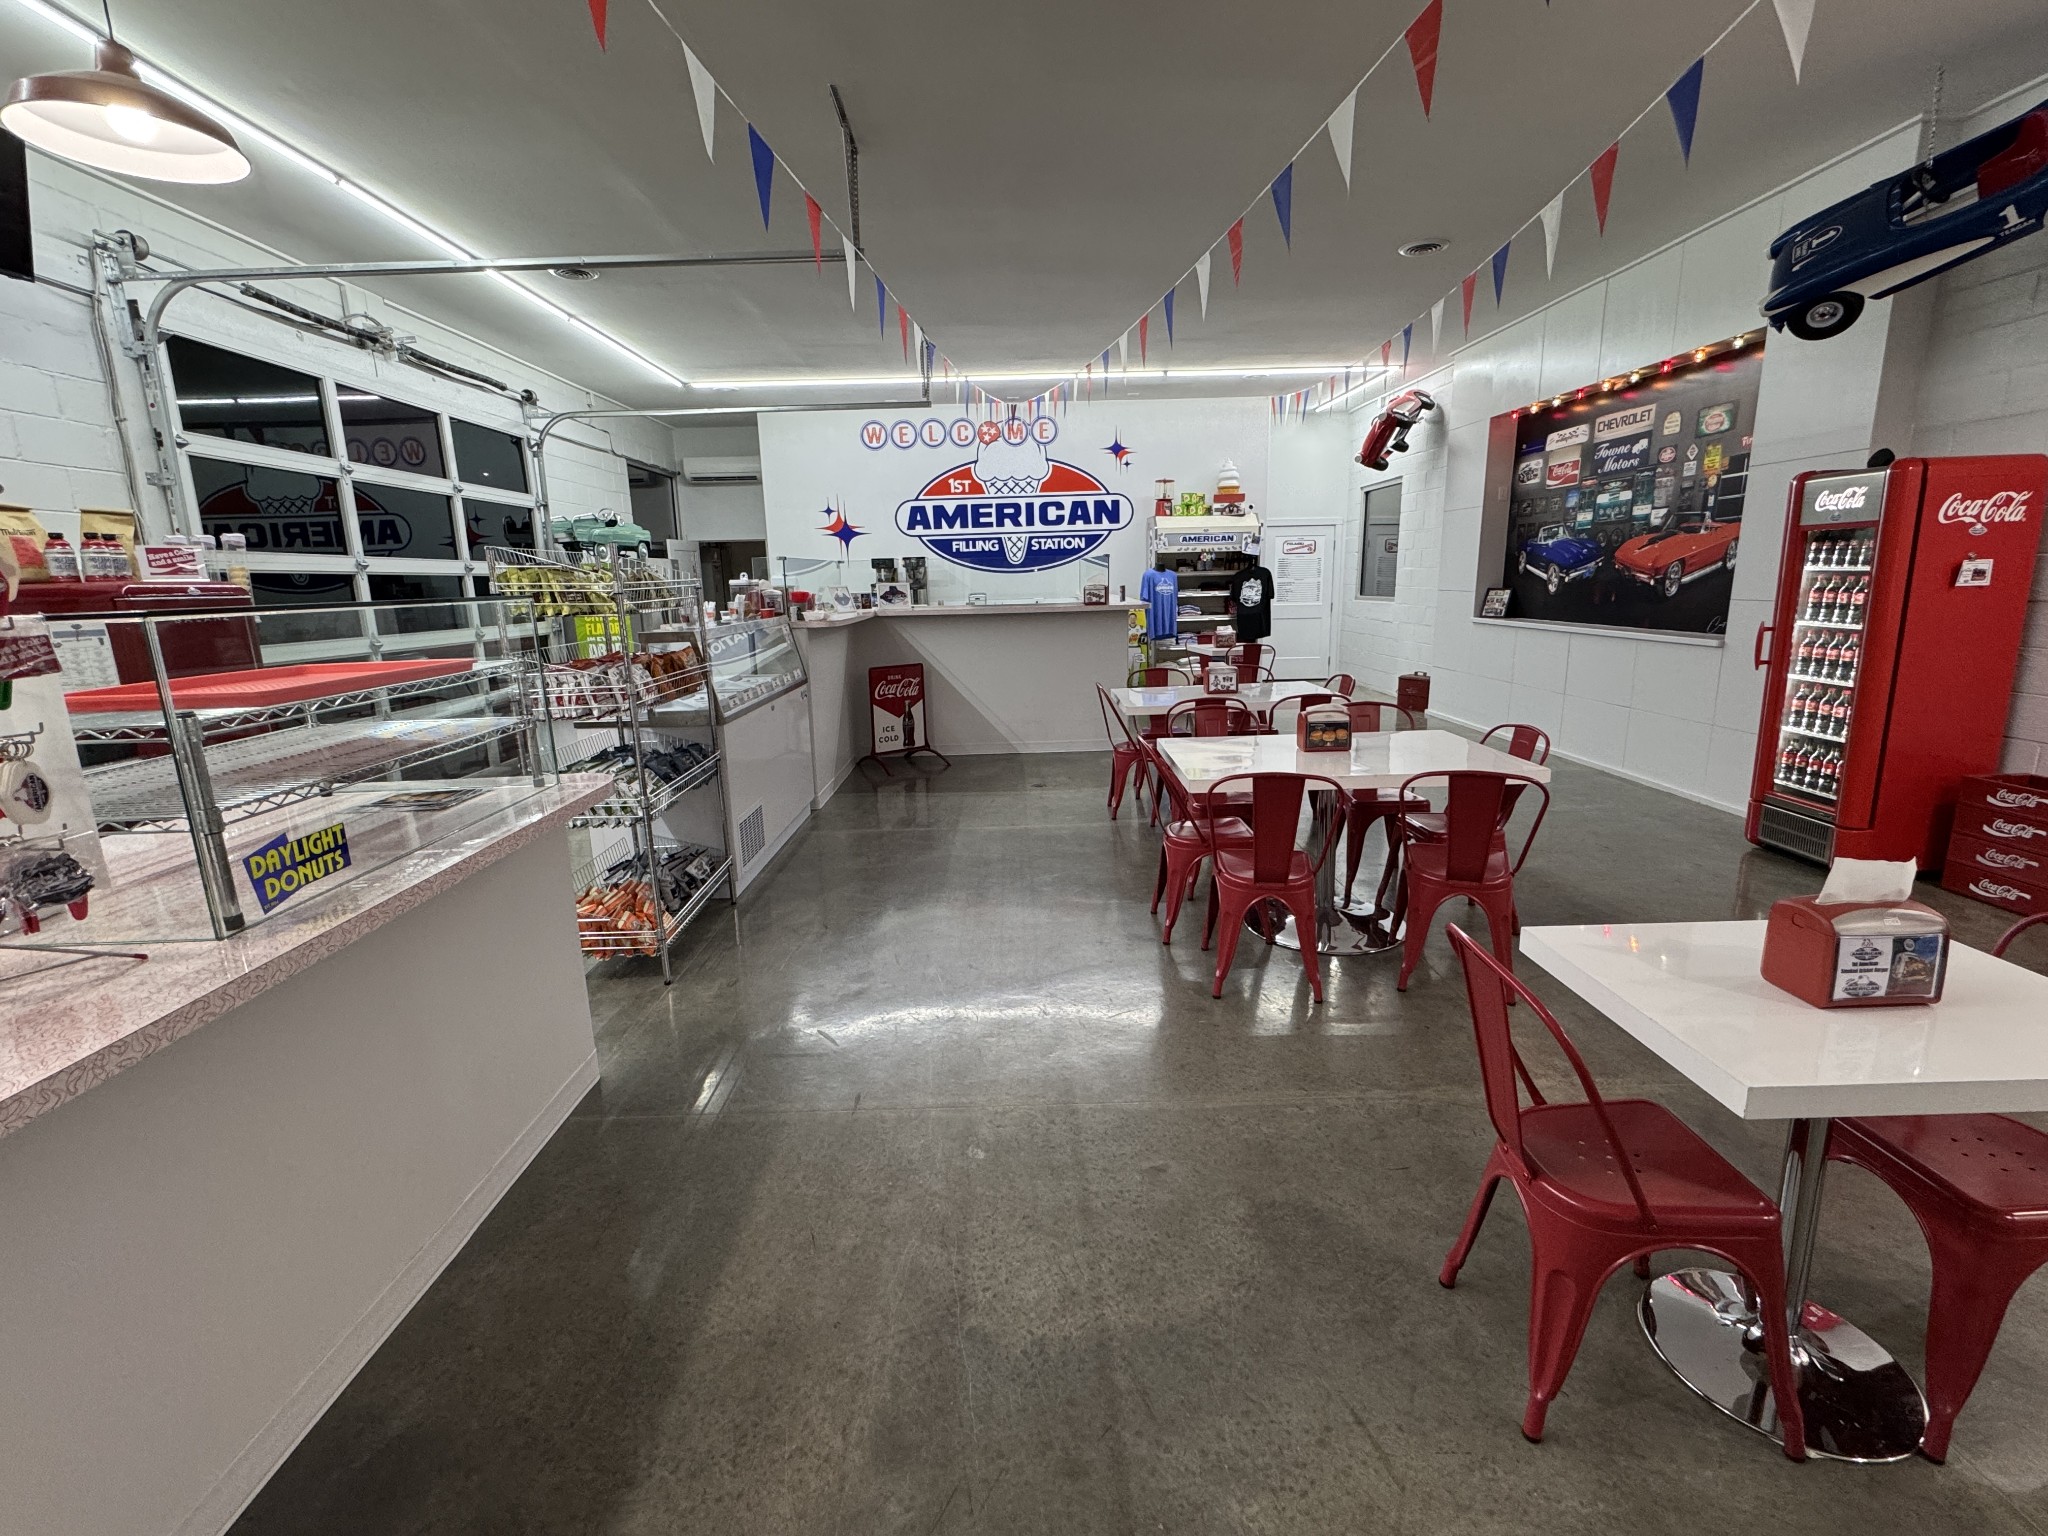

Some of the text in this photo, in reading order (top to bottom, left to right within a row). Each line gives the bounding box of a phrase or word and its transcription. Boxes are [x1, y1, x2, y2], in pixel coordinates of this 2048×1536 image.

[1998, 204, 2027, 229] 1
[1597, 408, 1653, 433] CHEVROLET
[1594, 443, 1631, 460] Towne
[1597, 456, 1640, 474] Motors
[948, 478, 972, 493] 1ST
[906, 499, 1121, 531] AMERICAN
[1938, 490, 2034, 524] Coca-Cola
[952, 537, 1086, 552] FILLING STATION
[1181, 535, 1234, 543] AMERICAN
[585, 623, 621, 636] FLAOR
[874, 677, 921, 700] Coca-Cola
[882, 725, 895, 733] ICE
[878, 734, 899, 743] COLD
[249, 823, 344, 880] DAYLIGHT
[264, 848, 345, 900] DONUTS
